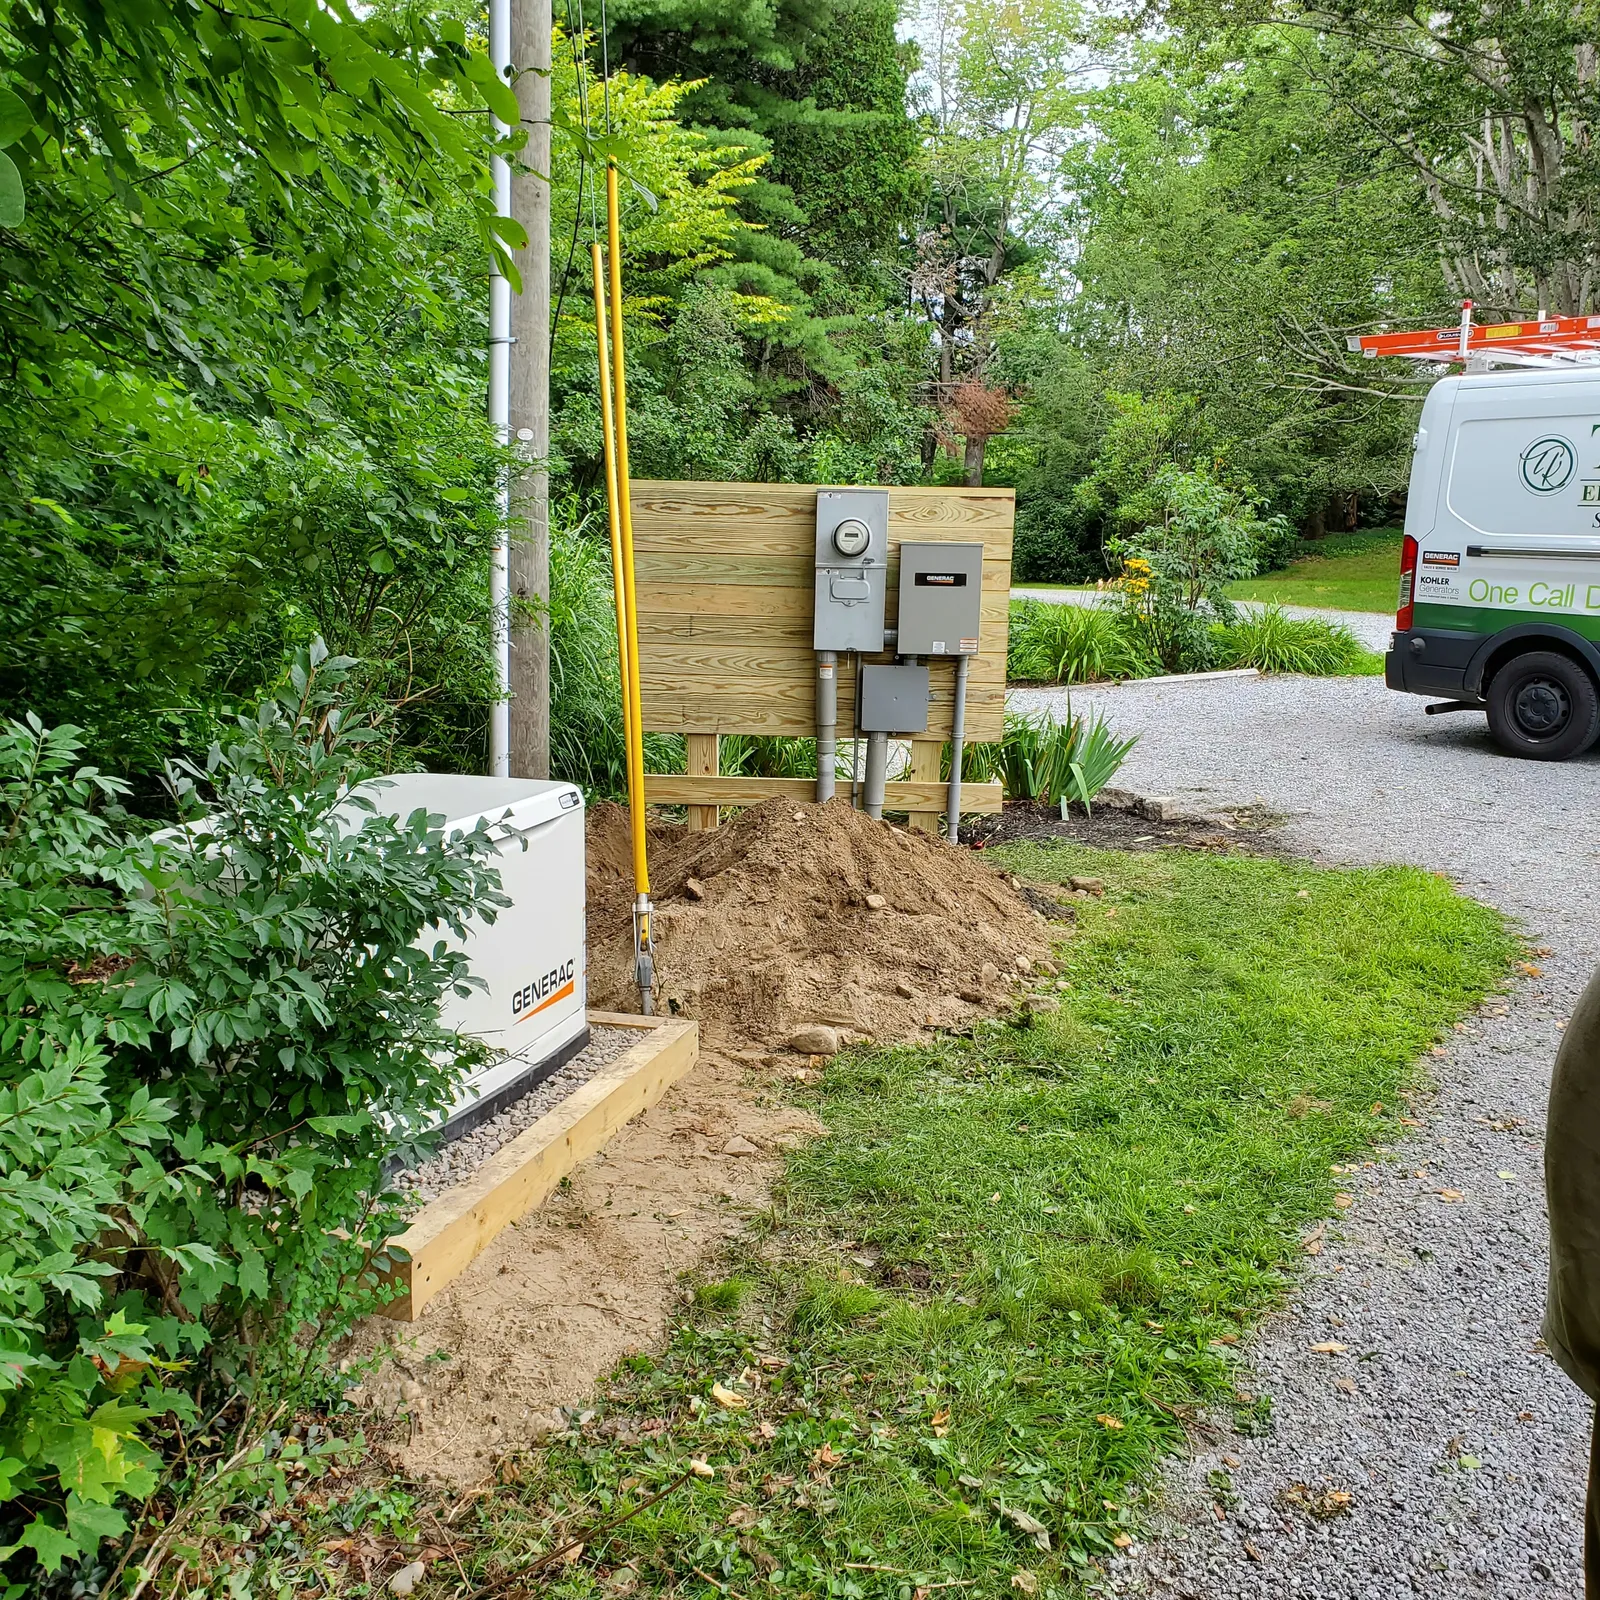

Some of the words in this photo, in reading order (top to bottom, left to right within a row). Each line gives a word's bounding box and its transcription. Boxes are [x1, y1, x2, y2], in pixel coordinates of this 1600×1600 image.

[1420, 577, 1449, 585] KOHLER
[1420, 584, 1459, 594] Generators
[1469, 579, 1518, 604] One
[1529, 582, 1575, 607] Call
[512, 958, 574, 1015] GENERAC
